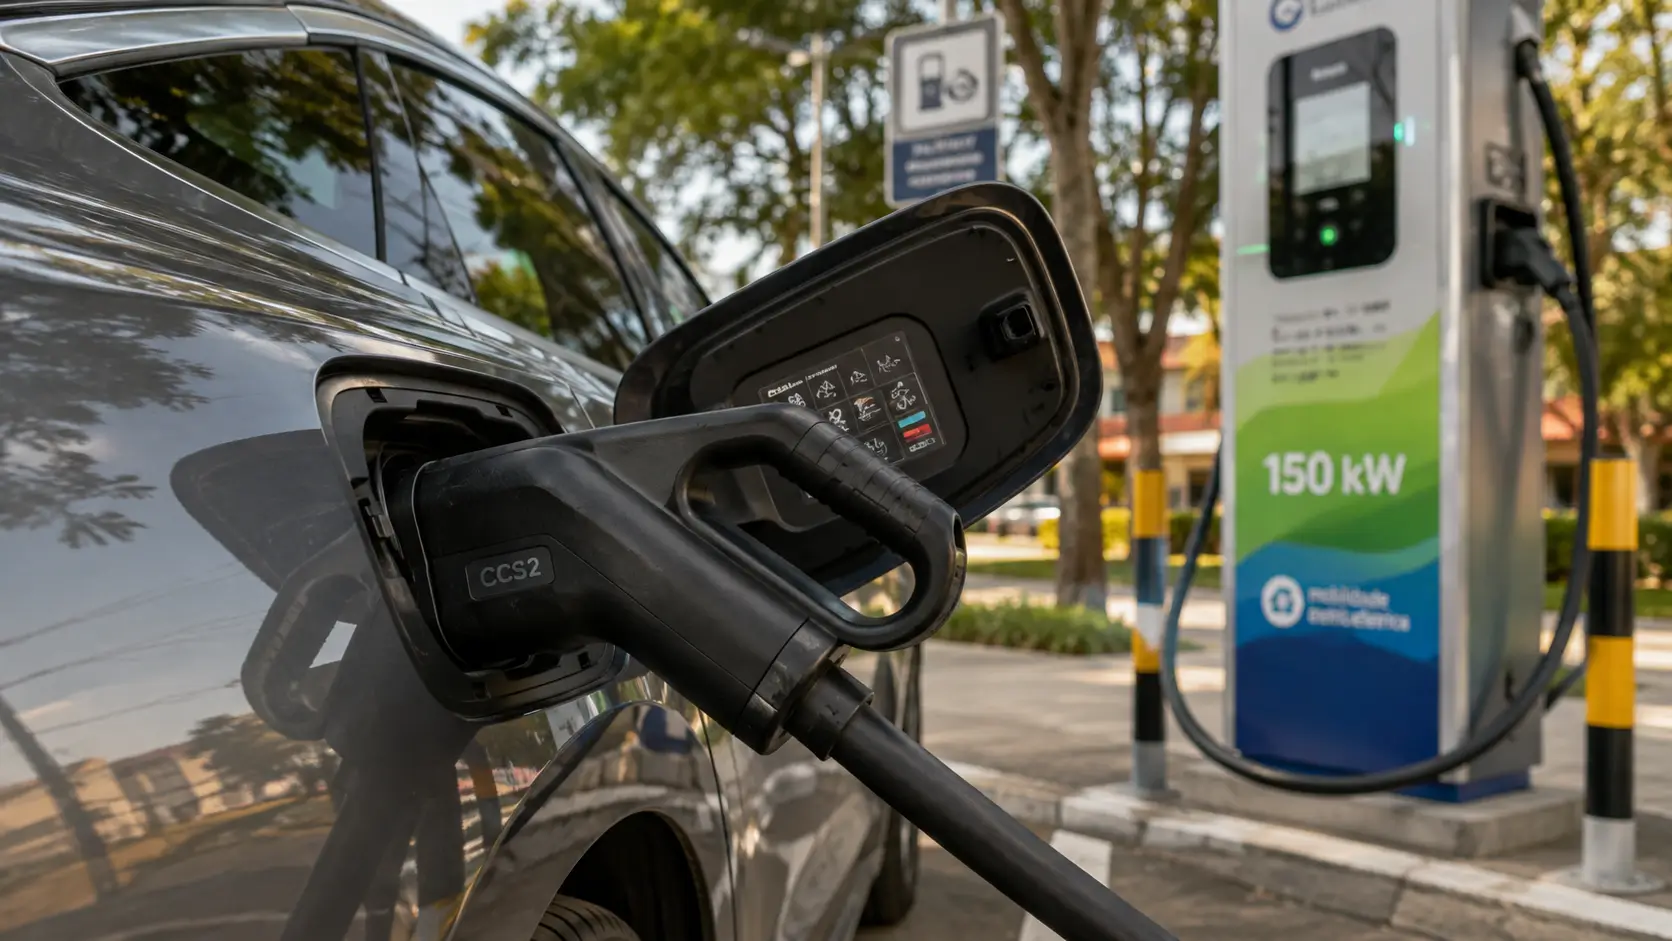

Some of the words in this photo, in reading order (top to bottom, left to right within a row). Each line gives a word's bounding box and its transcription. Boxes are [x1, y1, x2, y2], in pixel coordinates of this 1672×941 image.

[1263, 451, 1334, 496] 150
[1341, 453, 1407, 496] kW
[480, 557, 542, 587] CCS2
